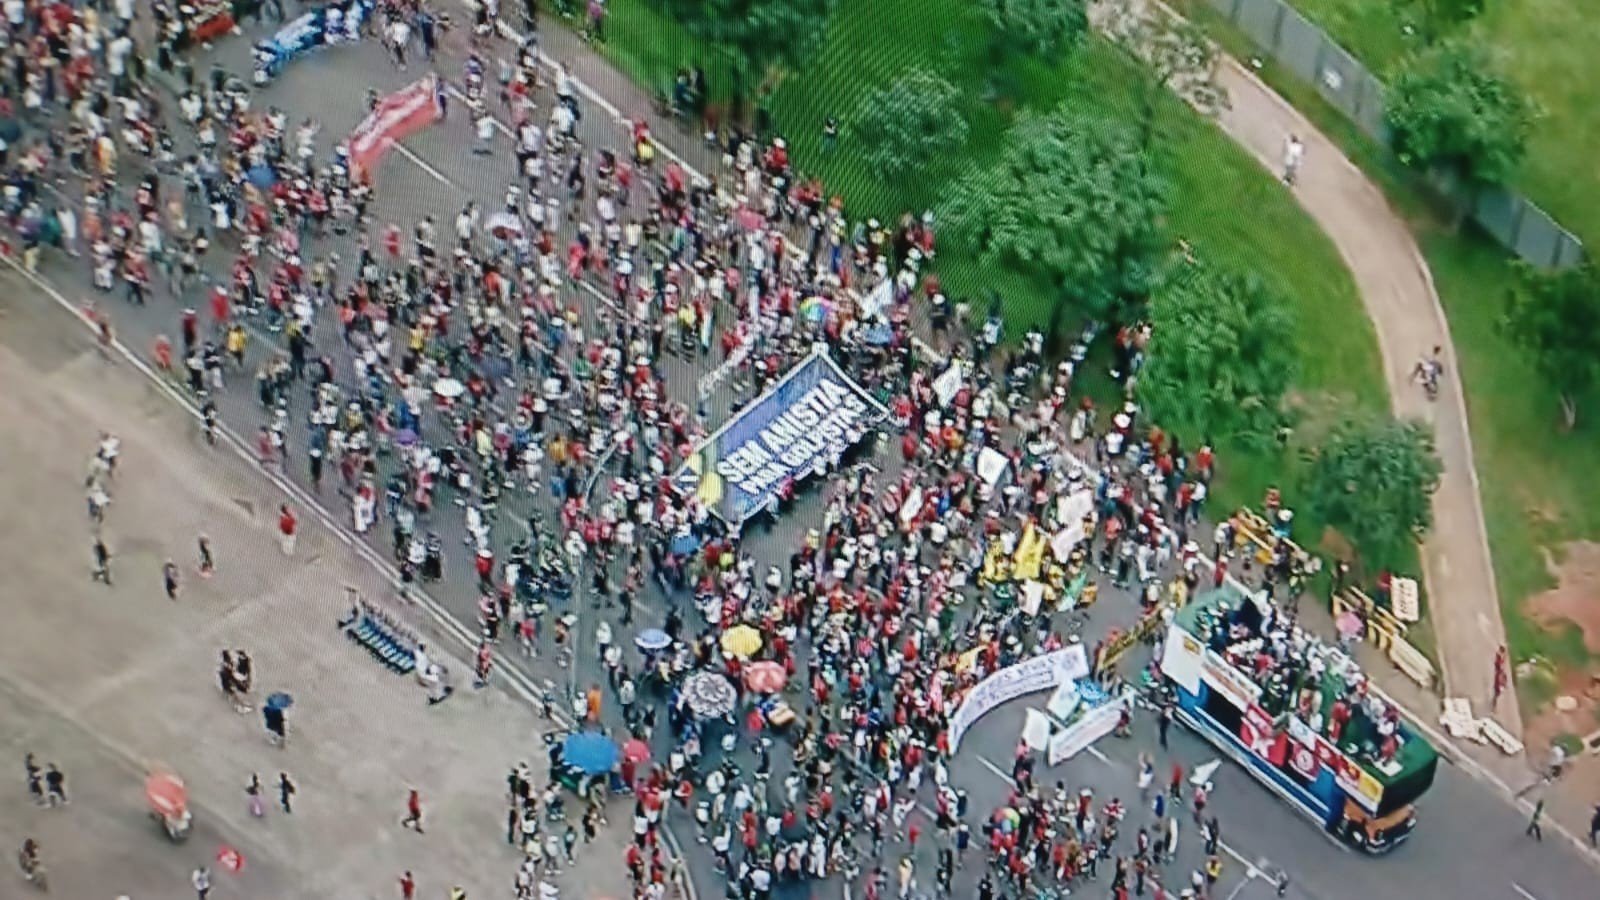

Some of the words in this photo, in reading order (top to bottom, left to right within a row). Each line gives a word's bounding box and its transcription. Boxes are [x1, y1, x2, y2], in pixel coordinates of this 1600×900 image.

[717, 440, 773, 482] SEM
[760, 379, 850, 452] ANISTIA
[738, 462, 793, 495] PARA
[781, 394, 867, 467] GOLPISTAS
